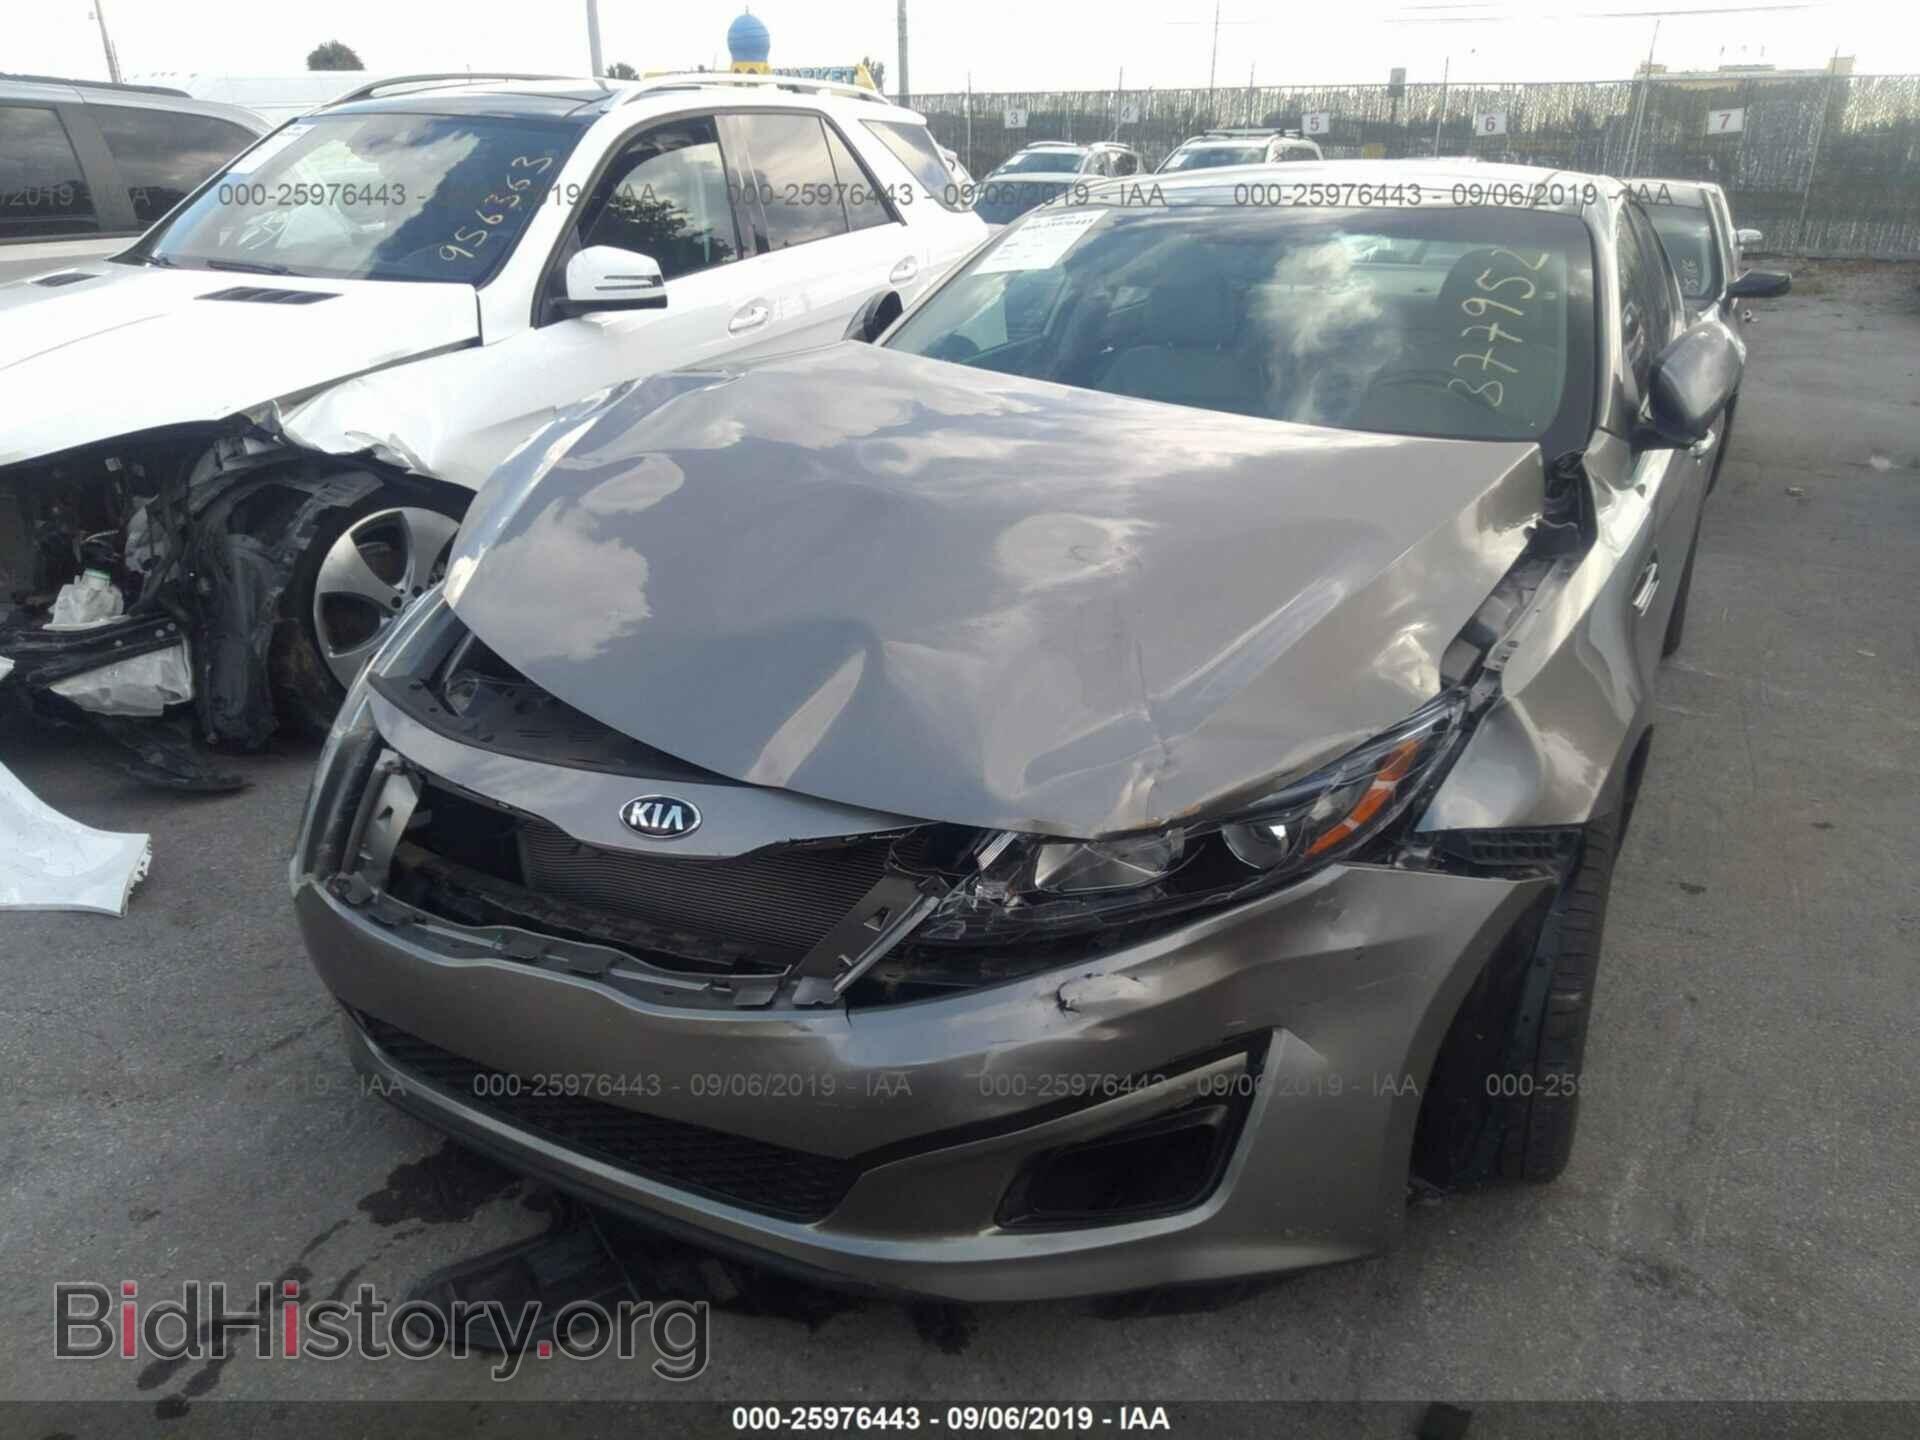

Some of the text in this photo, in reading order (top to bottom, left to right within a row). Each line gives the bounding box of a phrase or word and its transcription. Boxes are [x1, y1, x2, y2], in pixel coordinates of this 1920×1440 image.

[1010, 111, 1019, 126] 3
[1309, 116, 1320, 132] 5
[1484, 116, 1496, 132] 6
[1719, 112, 1731, 130] 7
[1447, 248, 1551, 407] 877952
[629, 801, 684, 831] KIA
